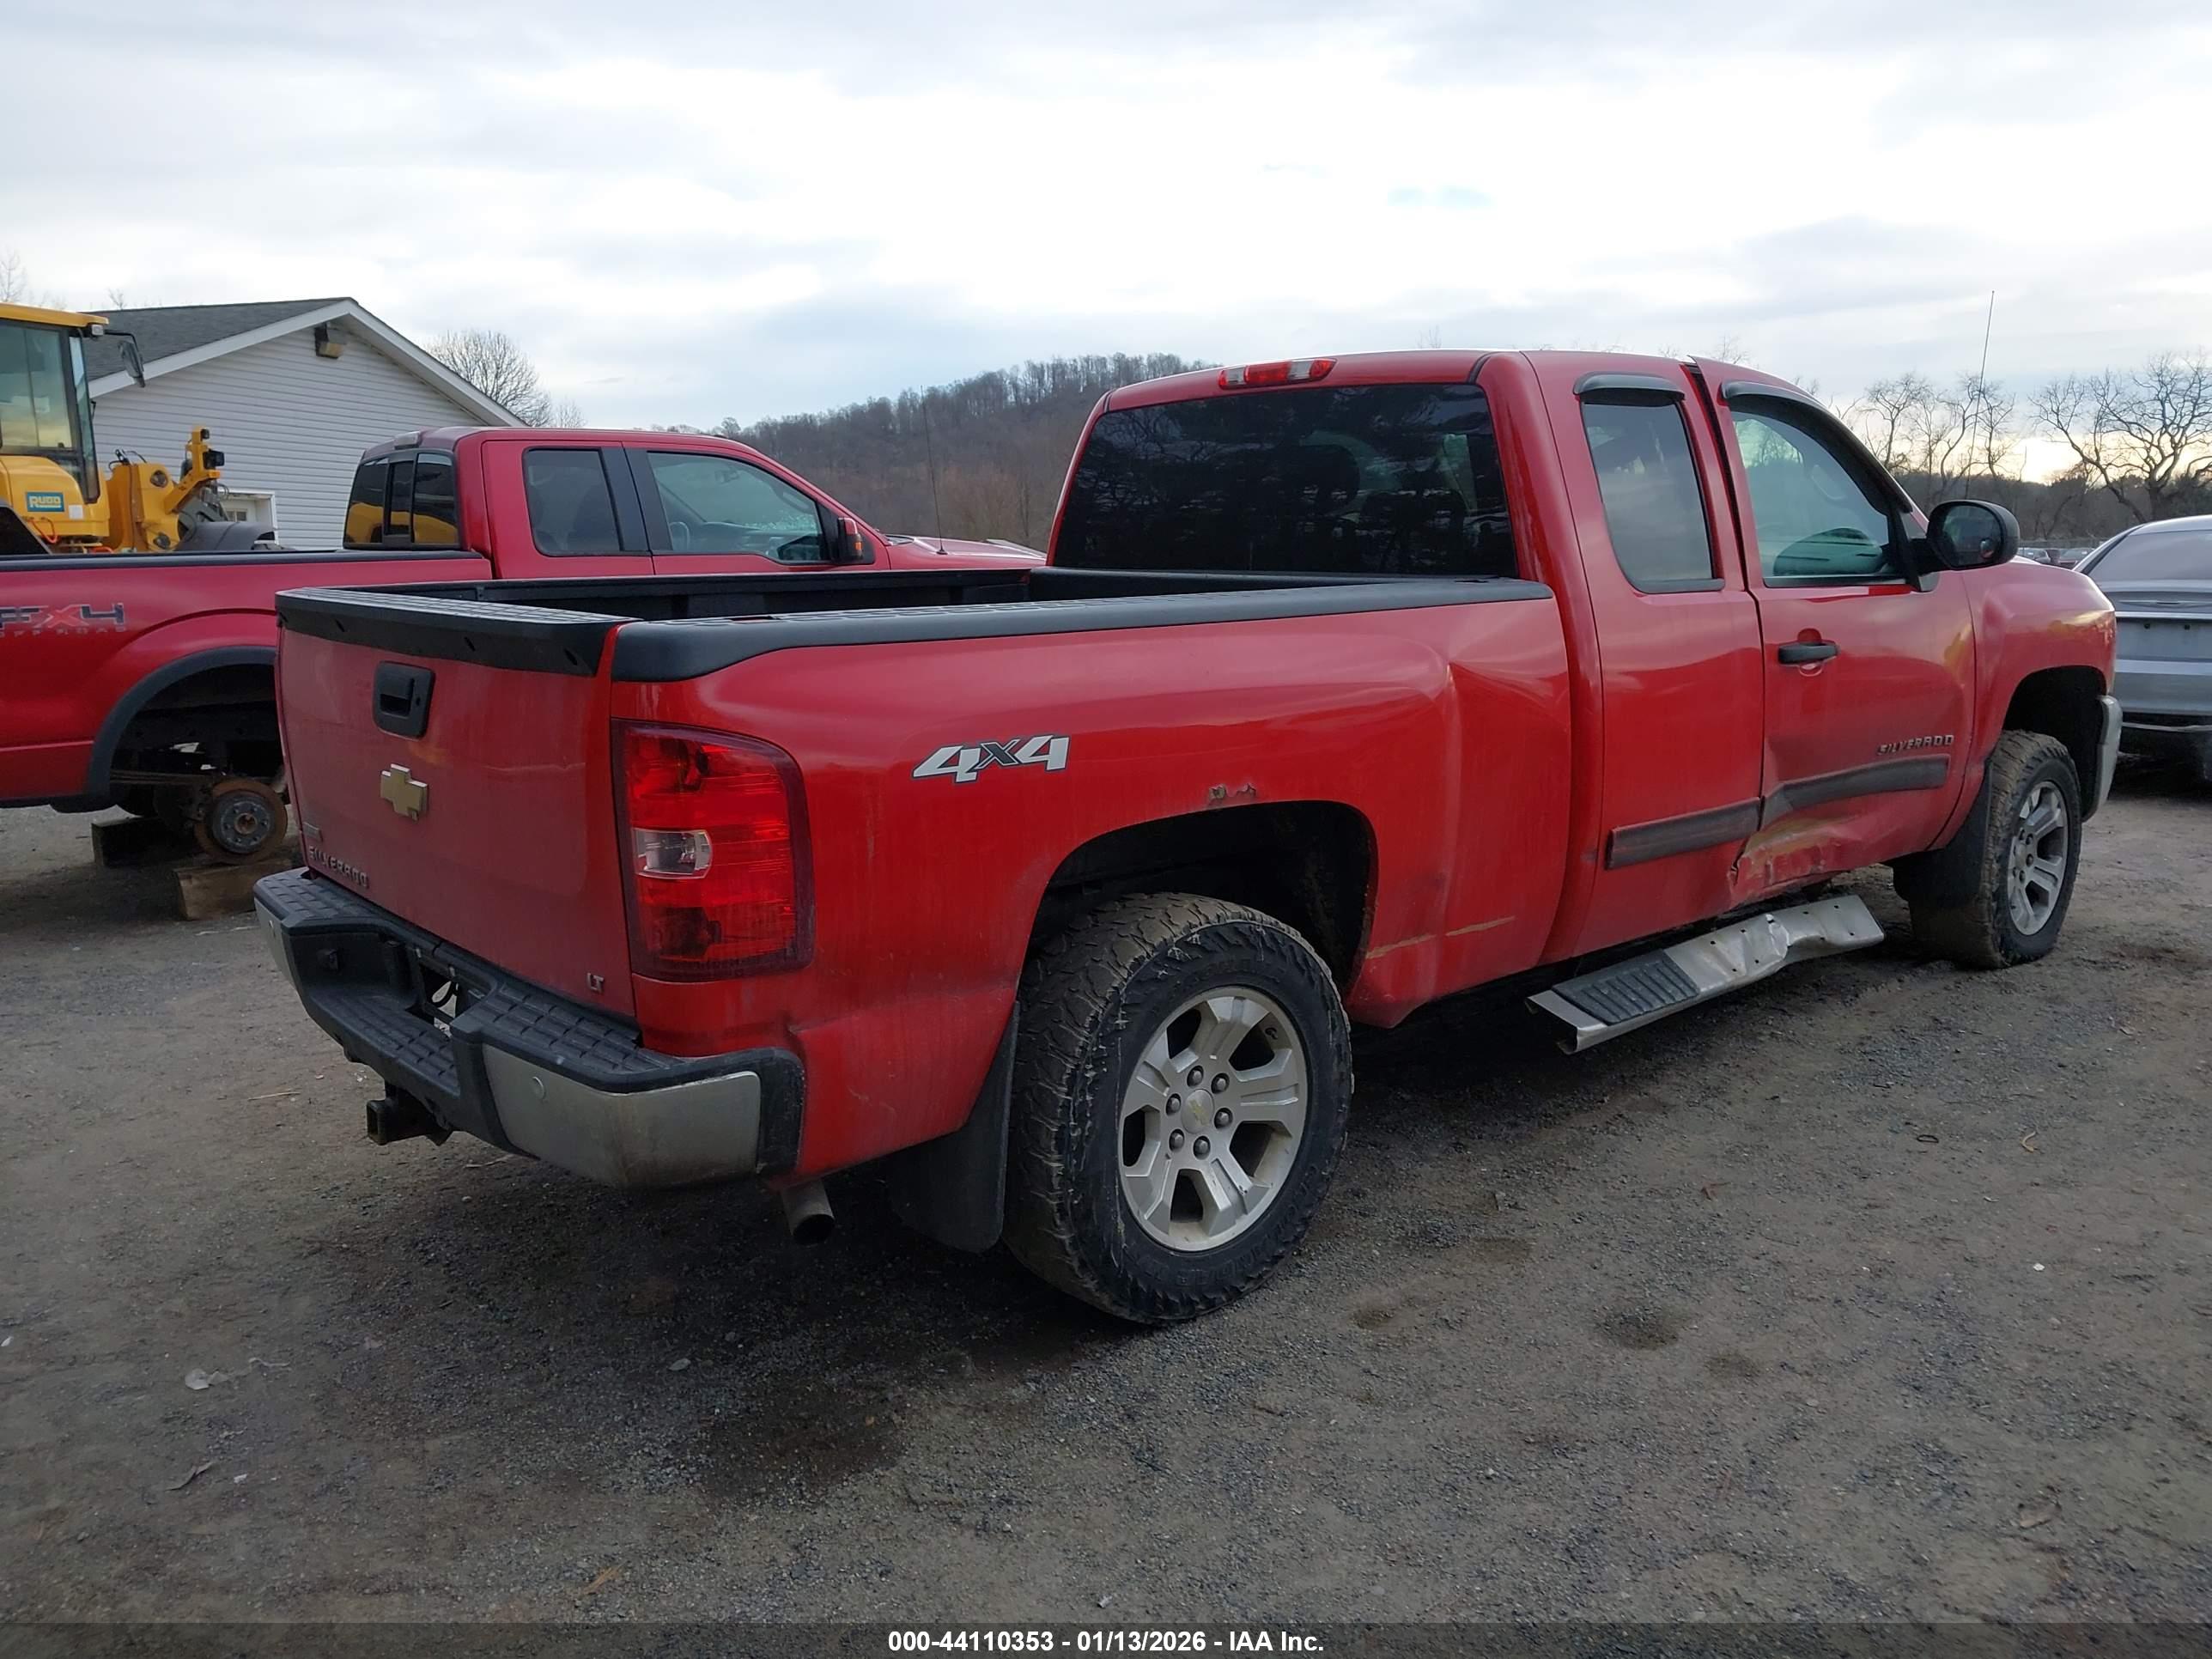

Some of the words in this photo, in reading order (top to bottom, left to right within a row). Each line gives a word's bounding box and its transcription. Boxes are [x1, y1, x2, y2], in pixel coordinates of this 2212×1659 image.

[0, 603, 125, 629] FX4
[1876, 734, 1954, 756] SILVERADO
[586, 972, 605, 993] LT
